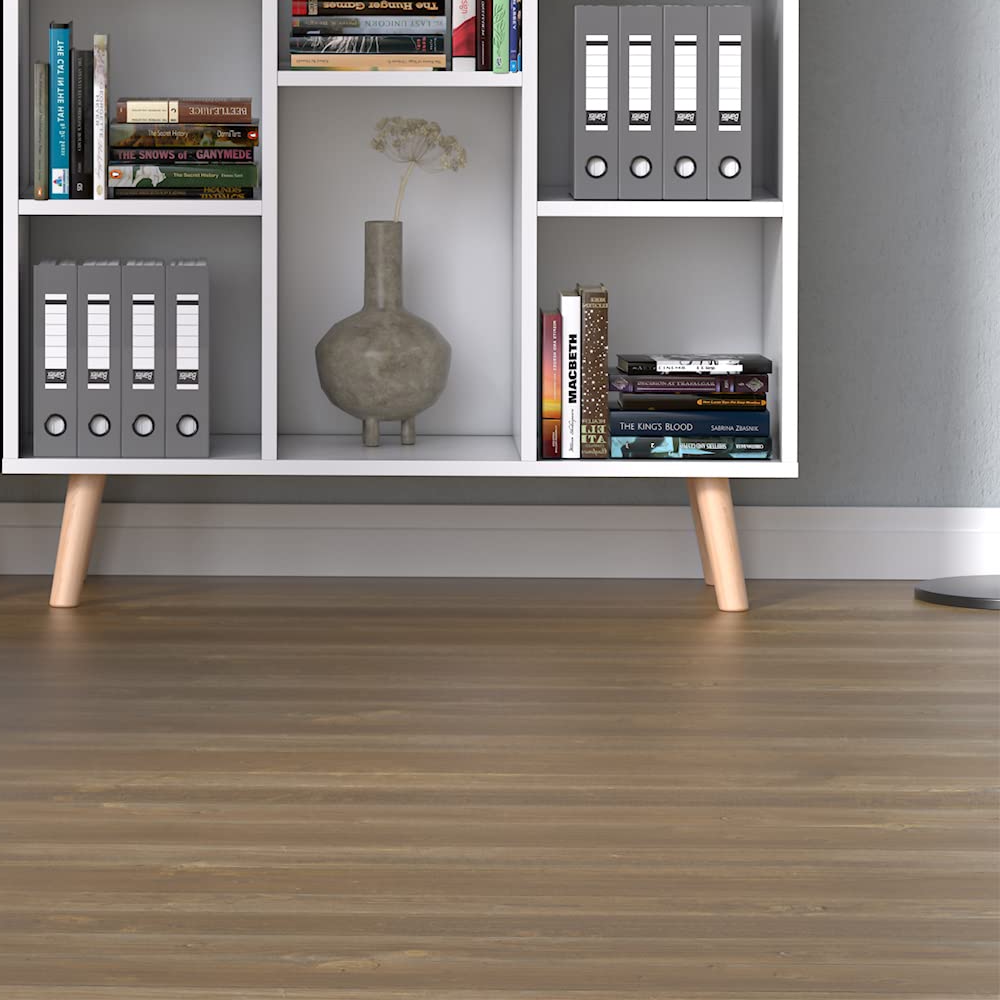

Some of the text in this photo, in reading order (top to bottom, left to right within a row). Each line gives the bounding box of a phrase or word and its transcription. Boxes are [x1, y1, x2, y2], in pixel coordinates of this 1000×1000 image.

[324, 1, 438, 11] The Hunger Games
[189, 107, 247, 115] BEETLEJUICE
[118, 149, 252, 160] THE SNOWS of GANYMEDE
[569, 334, 577, 404] MACBETH
[620, 423, 693, 431] THE KING'S BLOOD
